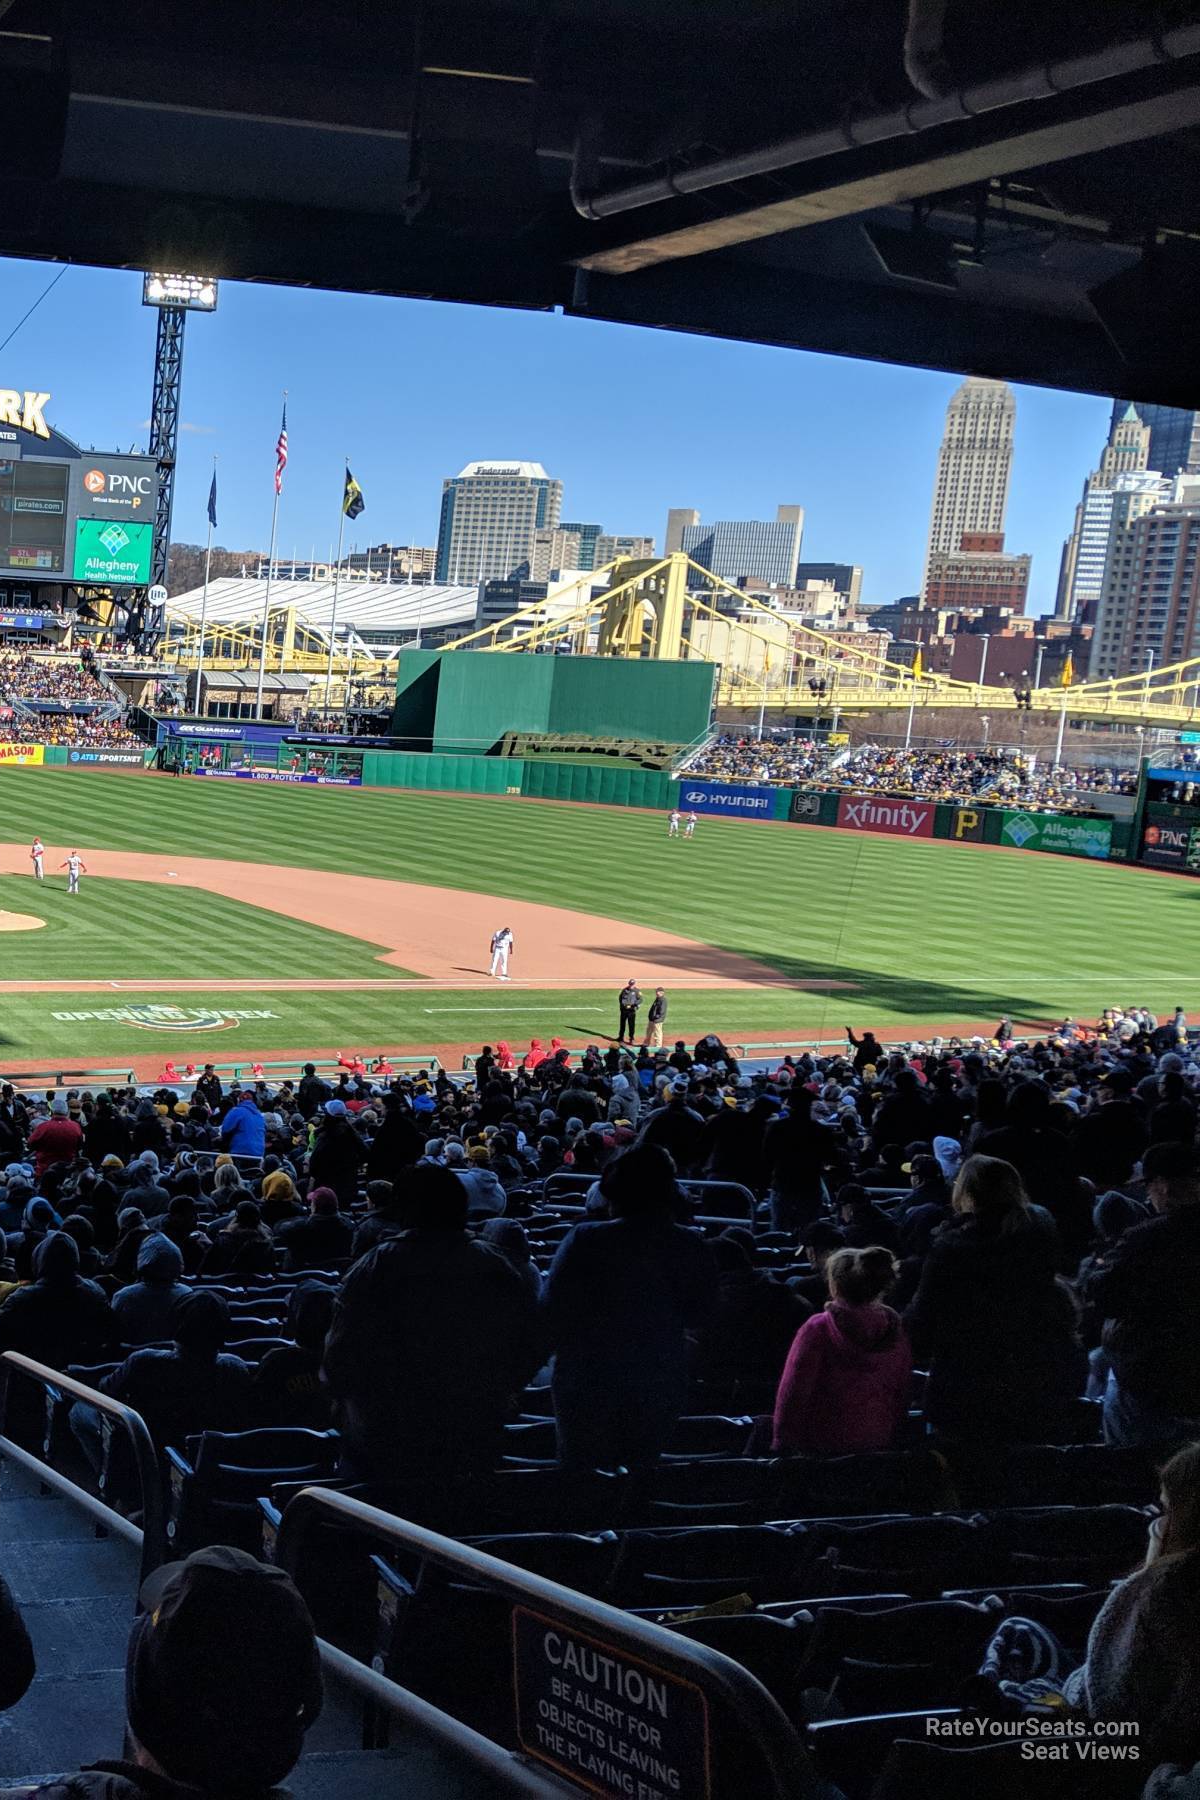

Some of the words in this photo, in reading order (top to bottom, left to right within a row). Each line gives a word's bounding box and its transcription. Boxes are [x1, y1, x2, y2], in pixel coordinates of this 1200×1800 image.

[473, 466, 521, 476] Federated
[108, 474, 152, 494] PNC
[17, 500, 61, 511] pirates.com
[85, 557, 140, 572] Allegheny
[85, 571, 107, 580] Health
[151, 589, 166, 600] Lite
[195, 726, 241, 734] GUARDIAN
[80, 753, 99, 762] AT&T
[99, 754, 142, 763] SPORTSNET
[710, 794, 768, 809] HYUNDAI
[844, 800, 928, 833] xfinity
[955, 810, 979, 838] P
[1042, 822, 1111, 846] Allegheny
[1160, 829, 1188, 847] PNC
[50, 1010, 188, 1021] OPENING
[189, 1009, 282, 1020] WEEK
[544, 1631, 668, 1719] CAUTION
[552, 1677, 571, 1701] BE
[575, 1691, 624, 1729] ALERT
[628, 1715, 661, 1750] FOR
[538, 1700, 606, 1749] OBJECTS
[609, 1735, 681, 1791] LEAVING
[536, 1724, 564, 1756] THE
[568, 1743, 634, 1794] PLAYING
